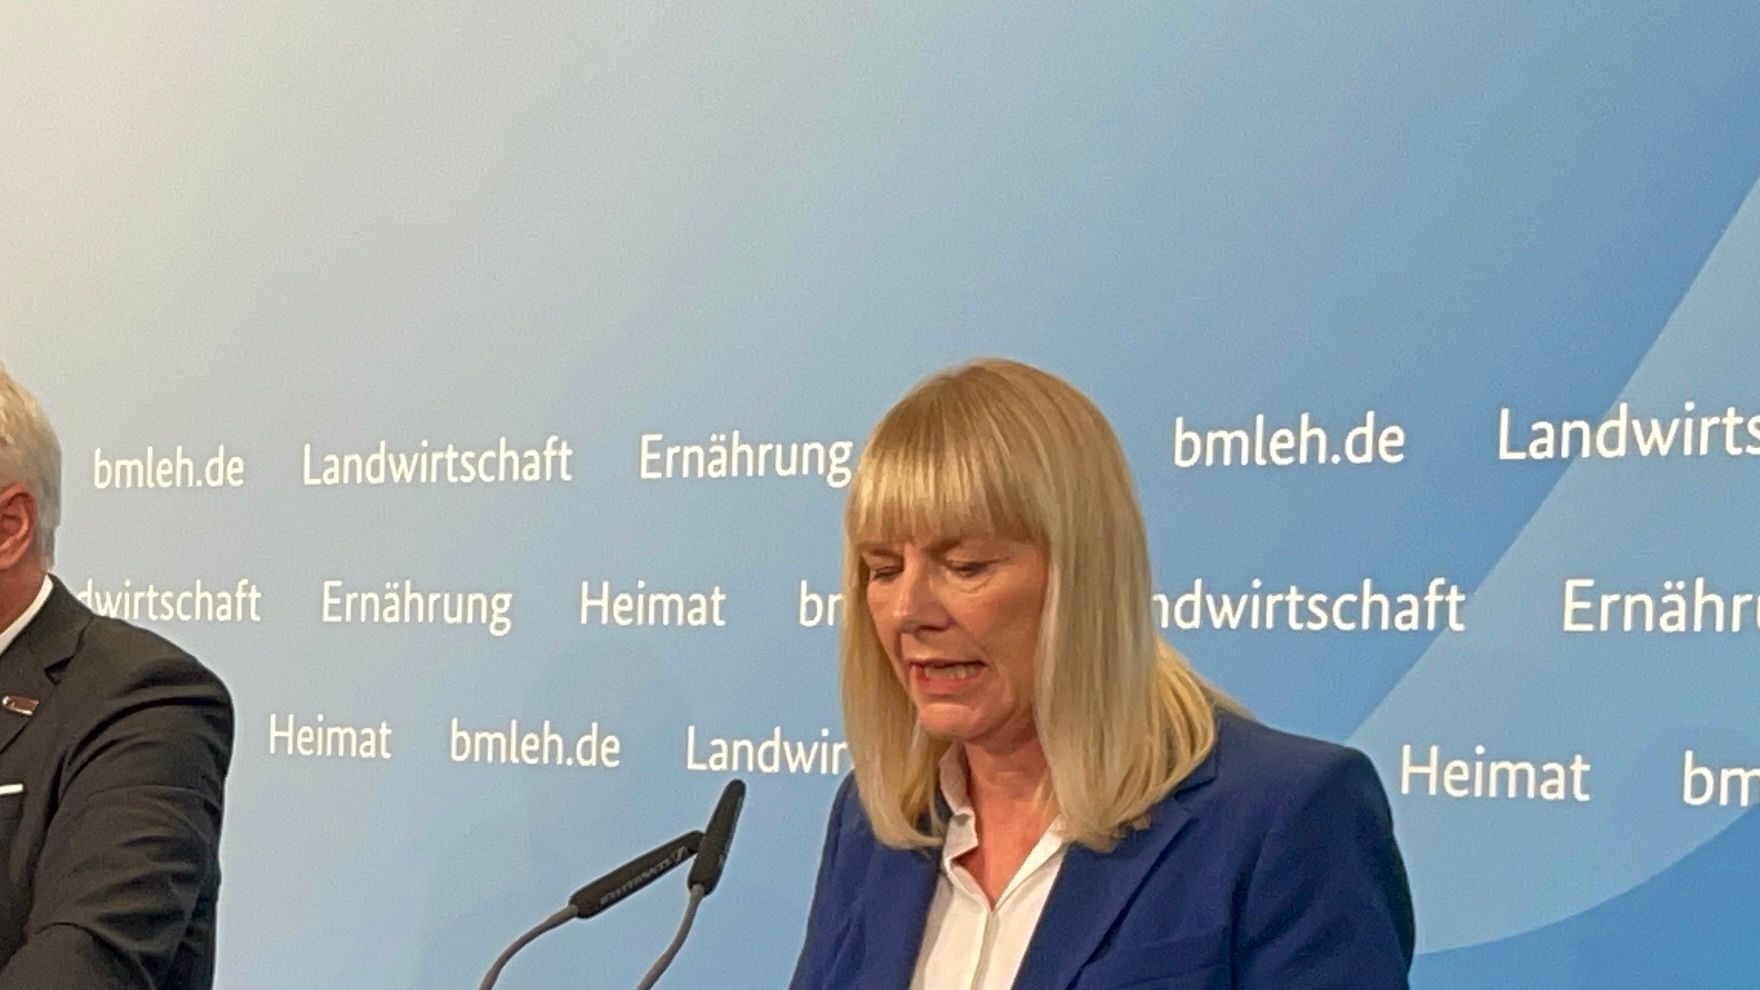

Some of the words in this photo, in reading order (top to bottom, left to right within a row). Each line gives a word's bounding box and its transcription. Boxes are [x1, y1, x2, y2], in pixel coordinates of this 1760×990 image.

[94, 445, 244, 489] bmleh.de
[303, 435, 574, 486] Landwirtschaft
[640, 430, 853, 488] Ernährung
[1173, 410, 1407, 468] bmleh.de
[322, 580, 513, 636] Ernährung
[580, 580, 727, 627] Heimat
[1562, 577, 1760, 633] Ernähr
[269, 714, 393, 760] Heimat
[450, 718, 621, 768] bmleh.de
[1400, 743, 1592, 803] Heimat
